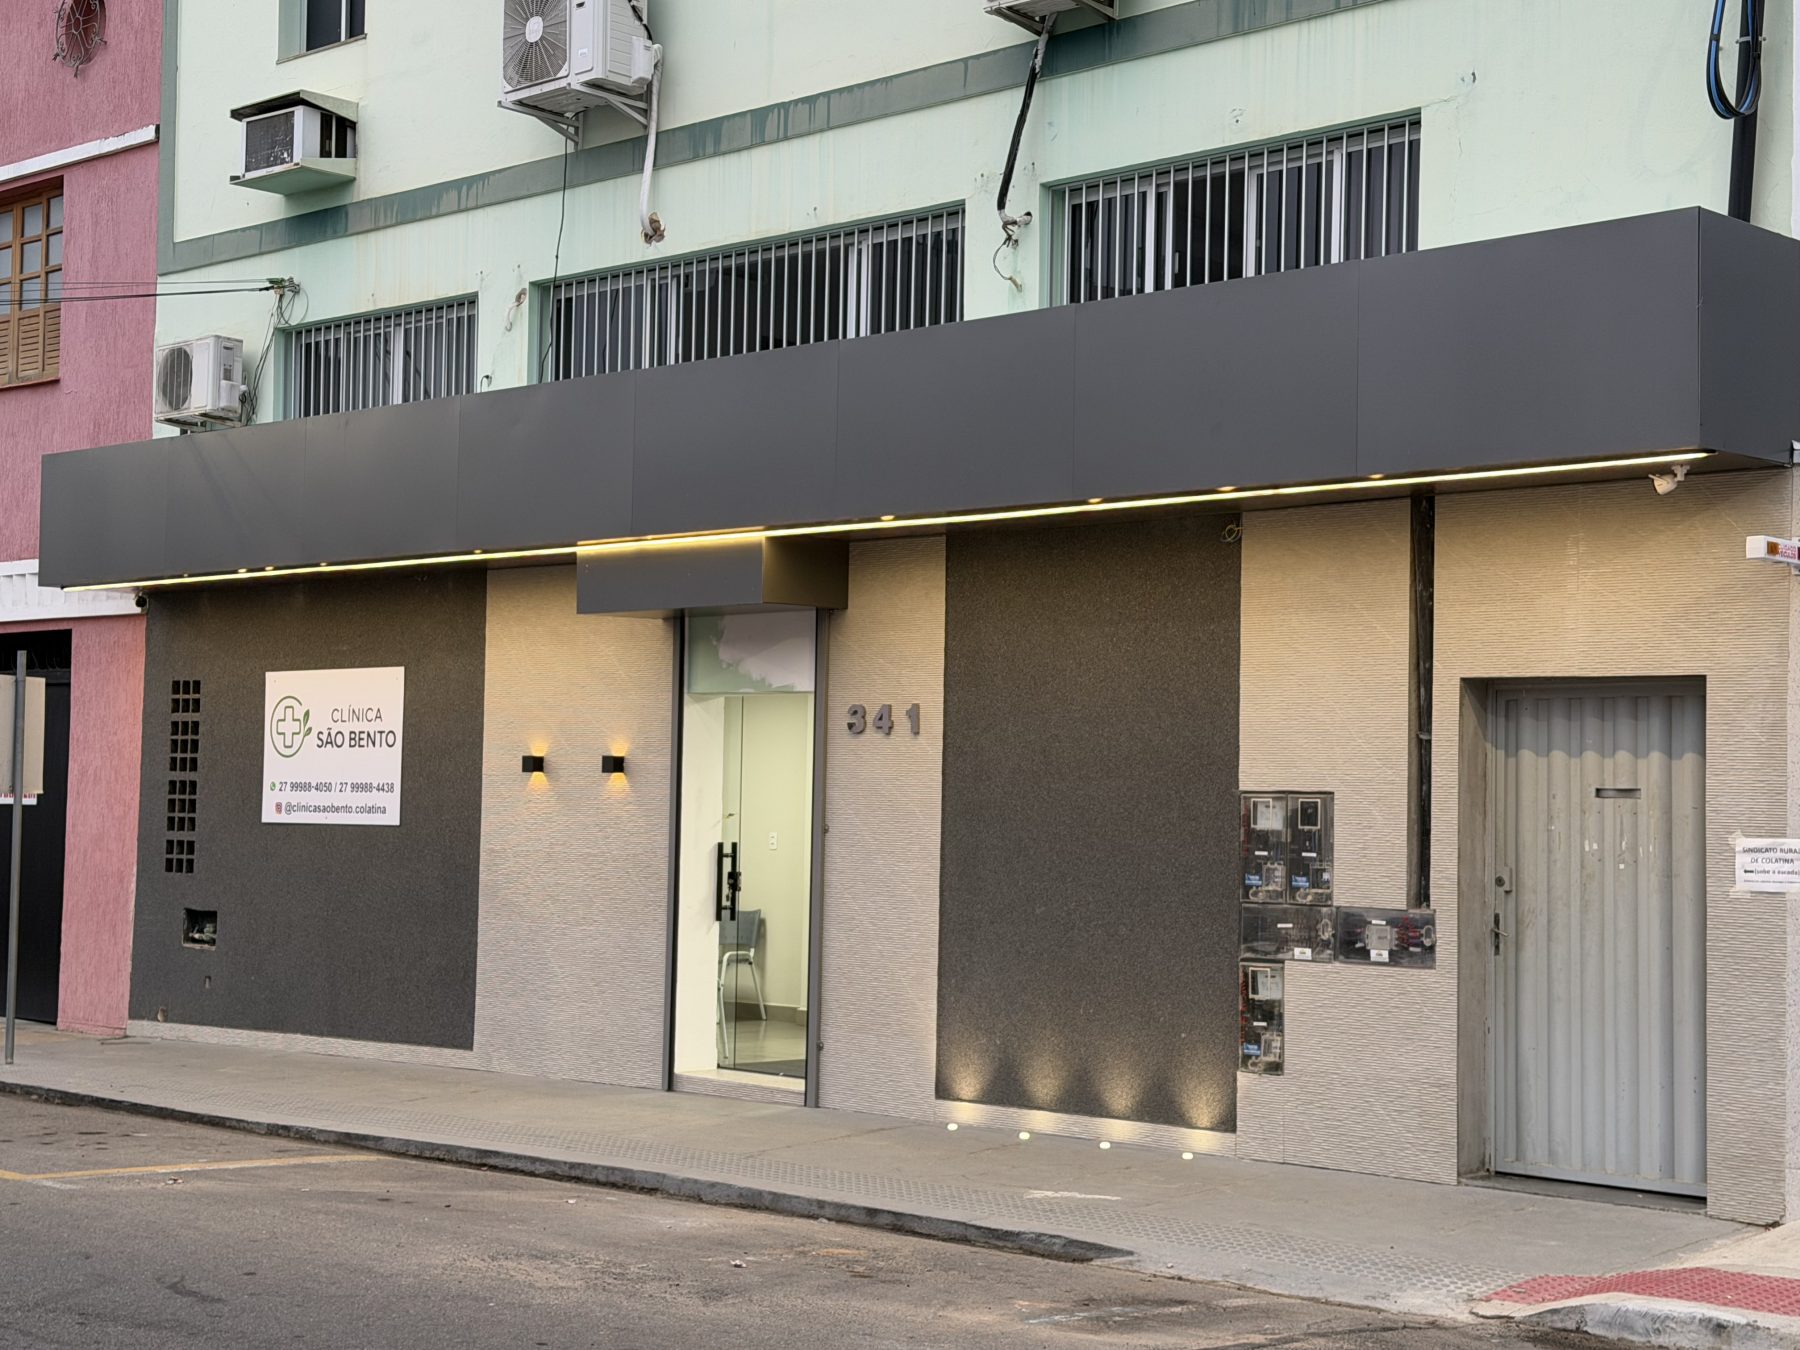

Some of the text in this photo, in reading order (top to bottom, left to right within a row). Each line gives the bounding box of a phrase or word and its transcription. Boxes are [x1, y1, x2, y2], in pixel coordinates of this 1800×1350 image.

[331, 705, 383, 723] CLÍNICA
[847, 703, 920, 735] 341
[316, 727, 396, 748] SÃO BENTO
[279, 781, 288, 791] 27
[339, 782, 348, 792] 27
[285, 802, 387, 815] @clinicasaobento.colatina
[1761, 857, 1795, 865] COLATINA
